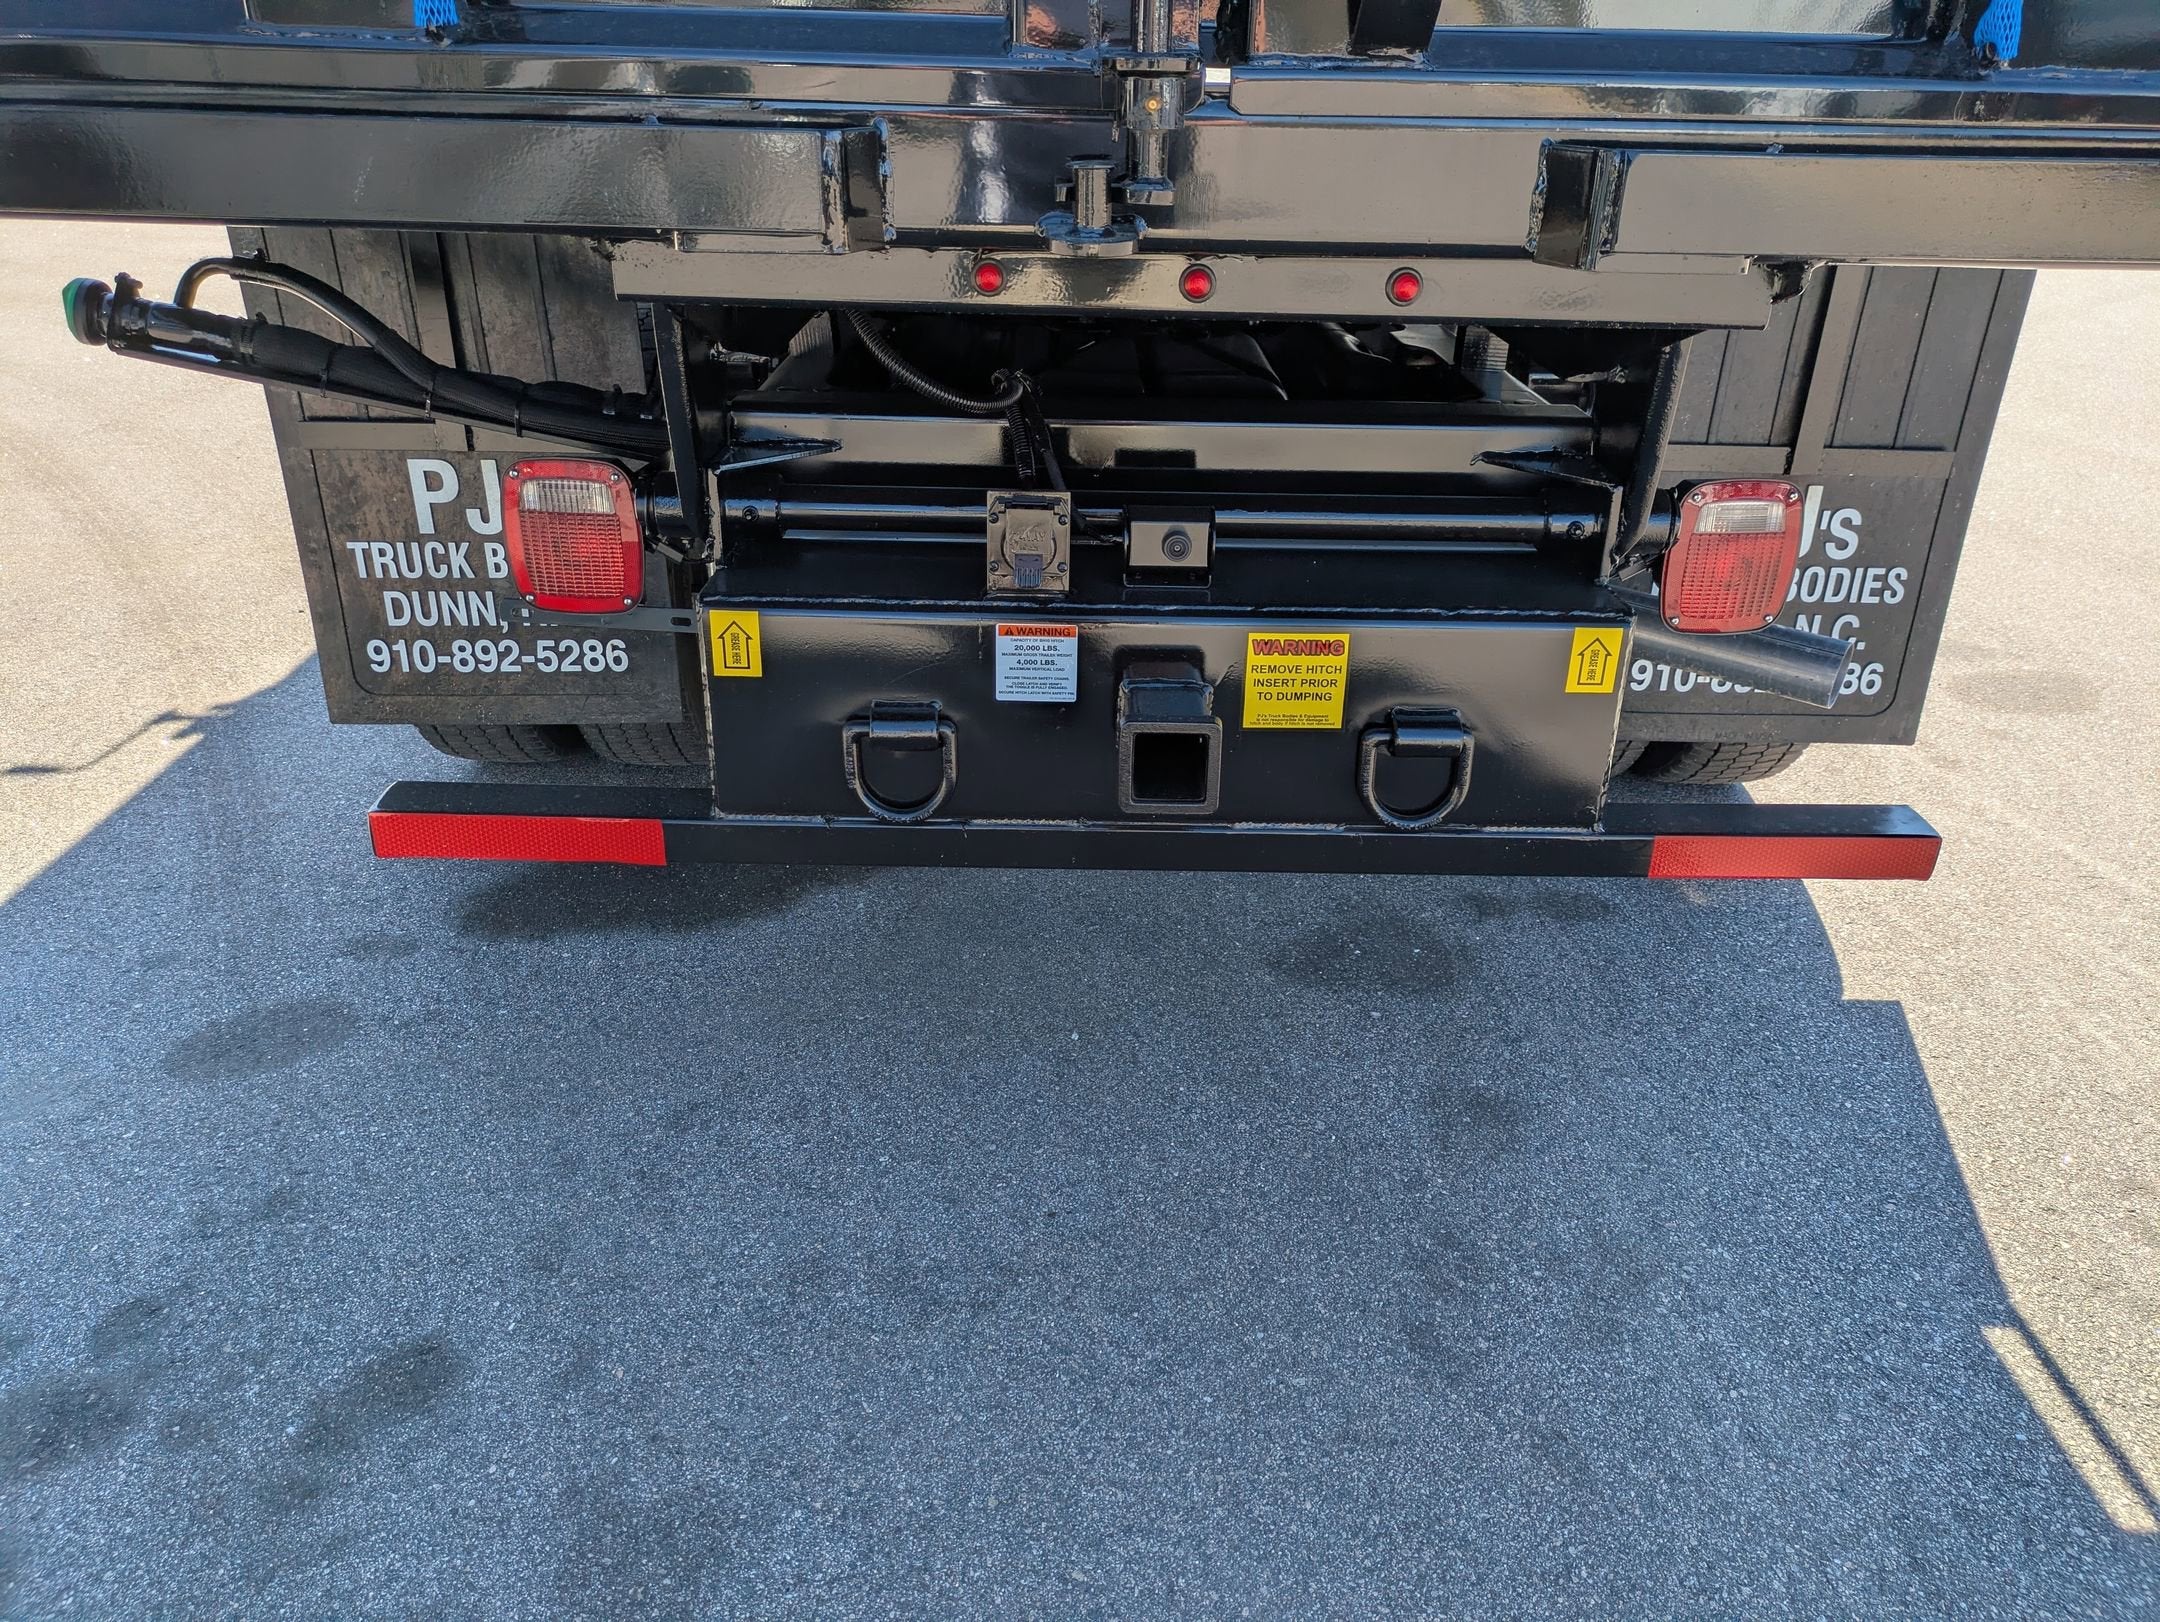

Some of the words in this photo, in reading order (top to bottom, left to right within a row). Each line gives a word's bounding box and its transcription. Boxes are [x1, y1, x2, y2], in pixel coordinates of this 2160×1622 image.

[346, 542, 476, 579] TRUCK
[484, 542, 508, 579] B
[383, 590, 508, 634] DUNN,
[1017, 628, 1070, 636] WARNING
[1252, 639, 1345, 656] WARNING
[366, 638, 629, 673] 910-892-5286
[1251, 665, 1302, 674] REMOVE
[1306, 665, 1342, 674] HITCH
[1253, 678, 1297, 687] INSERT
[1301, 679, 1338, 688] PRIOR
[1257, 692, 1272, 700] TO
[1277, 692, 1332, 701] DUMPING
